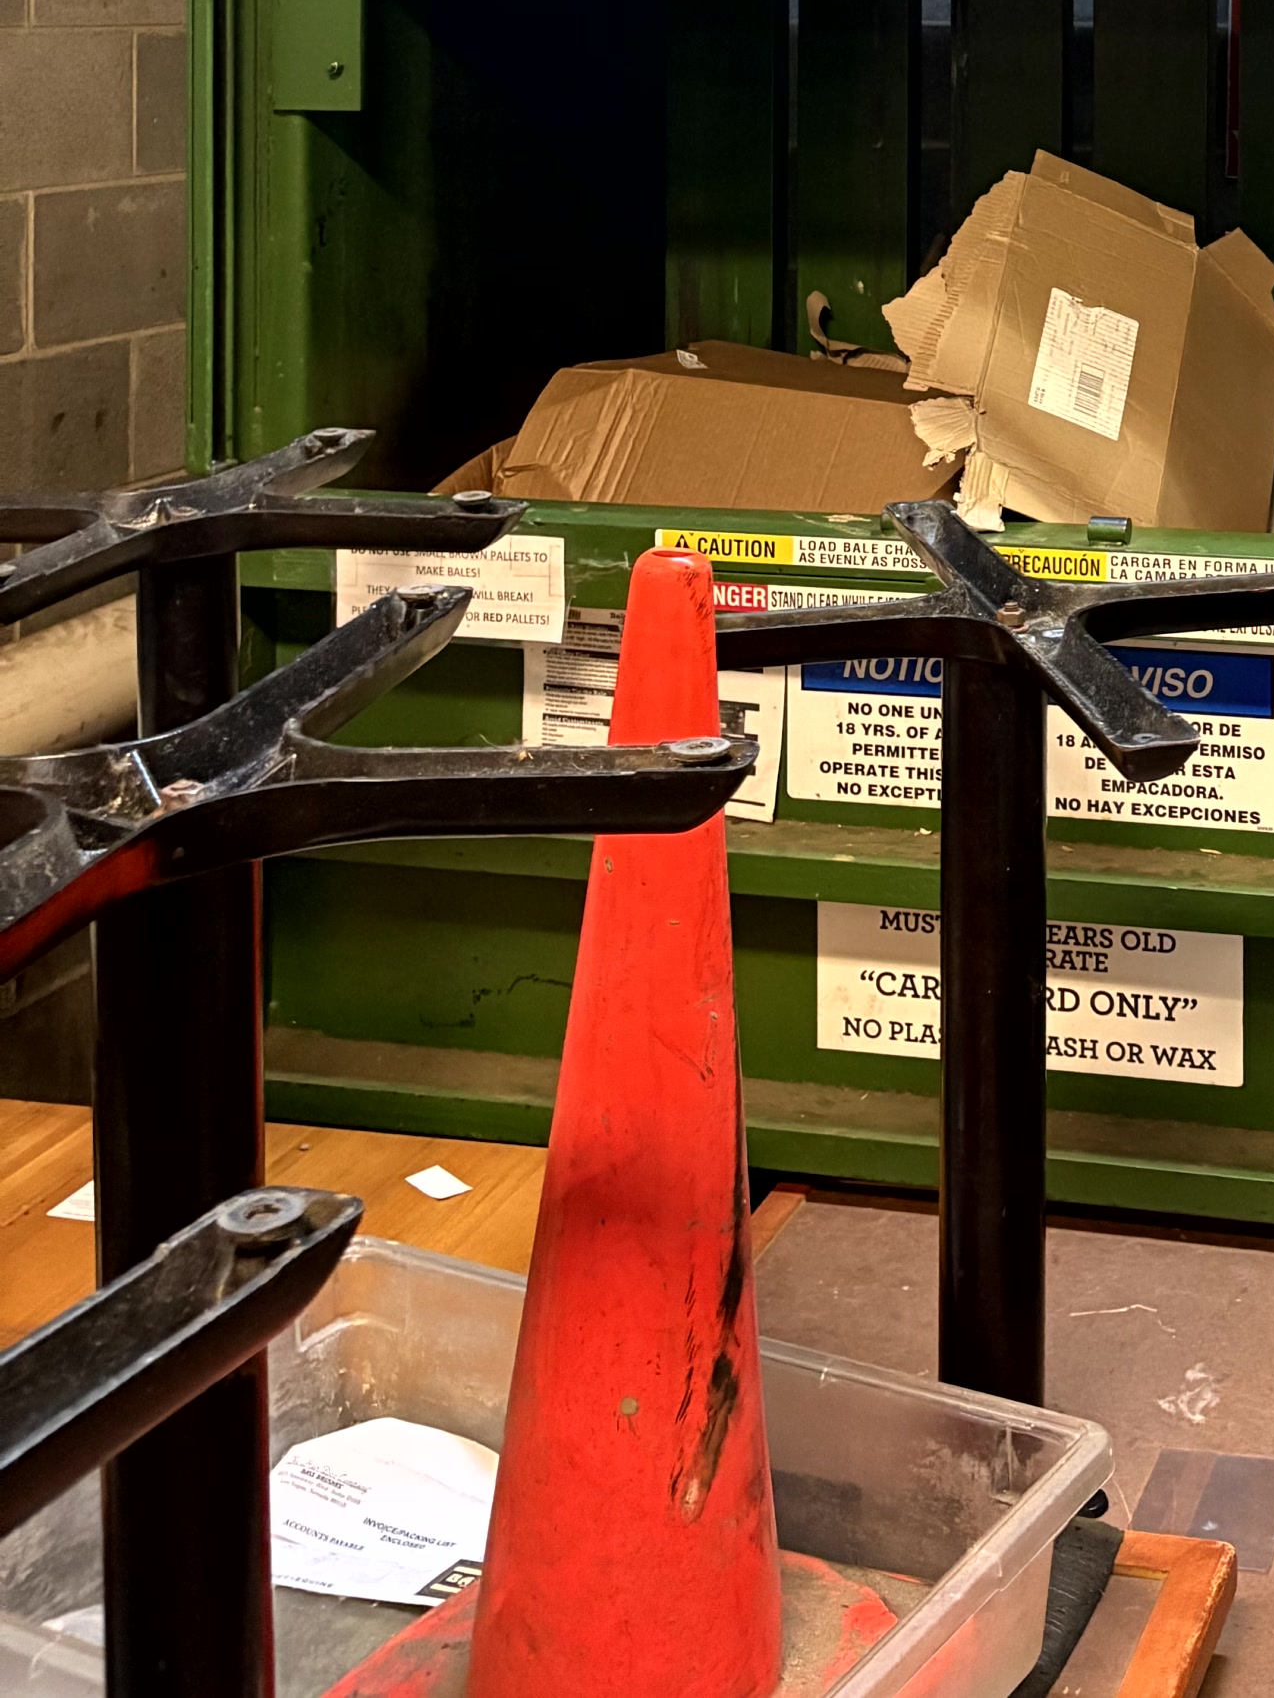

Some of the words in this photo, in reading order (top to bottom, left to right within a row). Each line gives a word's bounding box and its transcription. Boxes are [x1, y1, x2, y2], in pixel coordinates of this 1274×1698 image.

[697, 537, 775, 558] CAUTION
[799, 540, 836, 551] LOAD
[843, 541, 878, 553] BALE
[490, 551, 531, 562] PALLETS
[534, 553, 547, 562] TO
[799, 552, 816, 563] AS
[820, 554, 867, 566] EVENLY
[871, 555, 887, 566] AS
[1111, 555, 1171, 570] CARGAR
[1179, 559, 1198, 571] EN
[1204, 561, 1257, 573] FORMA
[416, 566, 444, 575] MAKE
[448, 567, 480, 577] BALES!
[498, 592, 533, 602] BREAK!
[772, 591, 803, 608] STAND
[483, 613, 503, 622] RED
[506, 614, 549, 625] PALLETS!
[843, 658, 943, 683] NOTIC
[848, 702, 872, 716] NO
[878, 704, 914, 718] ONE
[861, 723, 900, 737] YRS.
[906, 726, 928, 739] OF
[1057, 735, 1075, 748] 18
[819, 762, 899, 778] OPERATE
[1192, 764, 1236, 779] ESTA
[837, 782, 861, 795] NO
[1101, 780, 1224, 800] EMPACADORA.
[1055, 797, 1082, 811] NO
[1087, 800, 1124, 815] HAY
[1131, 803, 1260, 825] EXCEPCIONES
[1121, 932, 1176, 953] OLD
[842, 1018, 882, 1039] NO
[1105, 1042, 1144, 1064] OR
[1150, 1045, 1216, 1070] WAX
[283, 1519, 329, 1542] ACCOUNTS
